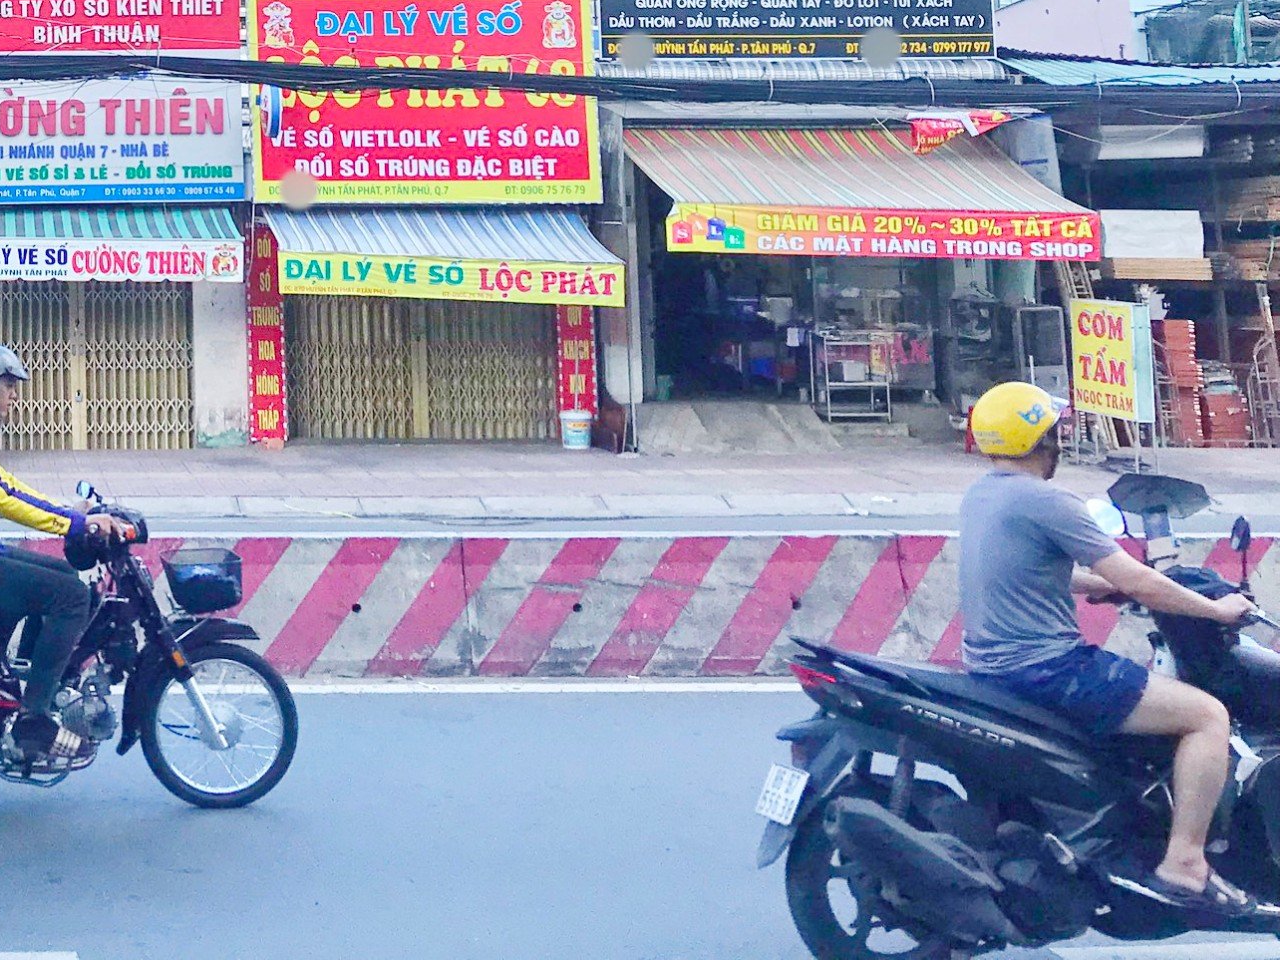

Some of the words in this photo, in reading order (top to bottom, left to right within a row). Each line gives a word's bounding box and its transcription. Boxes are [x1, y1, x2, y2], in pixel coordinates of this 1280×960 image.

[18, 0, 43, 18] TY
[638, 14, 675, 28] THƠM
[800, 17, 837, 28] XANH
[847, 16, 893, 28] LOTION
[33, 22, 82, 44] BÌNH
[94, 21, 160, 47] THUẬN
[316, 11, 372, 43] ĐẠI
[384, 1, 424, 36] LÝ
[428, 3, 469, 35] VÉ
[477, 1, 522, 35] SỐ
[910, 43, 926, 54] 734
[933, 42, 956, 53] 0799
[958, 42, 971, 53] 177
[973, 42, 990, 53] 977
[99, 88, 224, 138] THIÊN
[304, 123, 334, 147] SỐ
[340, 129, 441, 147] VIETLOLK
[464, 126, 491, 147] VÉ
[498, 122, 528, 147] SỐ
[534, 127, 580, 147] CÀO
[9, 143, 55, 160] NHÁNH
[60, 143, 96, 162] QUẬN
[100, 145, 108, 159] 7
[121, 142, 148, 158] NHÀ
[5, 167, 24, 181] VÉ
[29, 164, 49, 181] SỐ
[74, 170, 85, 180] &
[156, 162, 176, 179] SỐ
[182, 162, 233, 179] TRÚNG
[340, 152, 370, 176] SỐ
[376, 155, 450, 177] TRÚNG
[456, 155, 503, 180] ĐẶC
[509, 155, 557, 180] BIỆT
[520, 185, 544, 195] 0906
[547, 185, 558, 195] 75
[560, 185, 572, 195] 76
[574, 185, 586, 195] 79
[757, 210, 818, 232] GIẢM
[827, 212, 866, 233] GIÁ
[873, 216, 926, 235] 20%
[949, 218, 1003, 236] 30%
[1011, 214, 1053, 237] TẤT
[1060, 216, 1093, 238] CẢ
[757, 233, 805, 251] CÁC
[813, 234, 864, 256] MẶT
[871, 236, 937, 254] HÀNG
[943, 239, 1023, 256] TRONG
[1029, 242, 1094, 258] SHOP
[18, 245, 38, 265] VÉ
[45, 243, 69, 265] SỐ
[72, 243, 141, 275] CƯỜNG
[146, 244, 206, 275] THIÊN
[285, 259, 331, 285] ĐẠI
[342, 256, 372, 282] LÝ
[383, 258, 417, 284] VÉ
[428, 259, 464, 286] SỐ
[479, 262, 532, 298] LỘC
[541, 266, 617, 296] PHÁT
[252, 303, 280, 327] TRÚNG
[1077, 309, 1125, 341] CƠM
[258, 340, 275, 361] HOA
[1079, 346, 1128, 387] TẤM
[256, 368, 280, 396] HỒNG
[1076, 390, 1103, 409] NGỌC
[257, 403, 280, 431] THẤP
